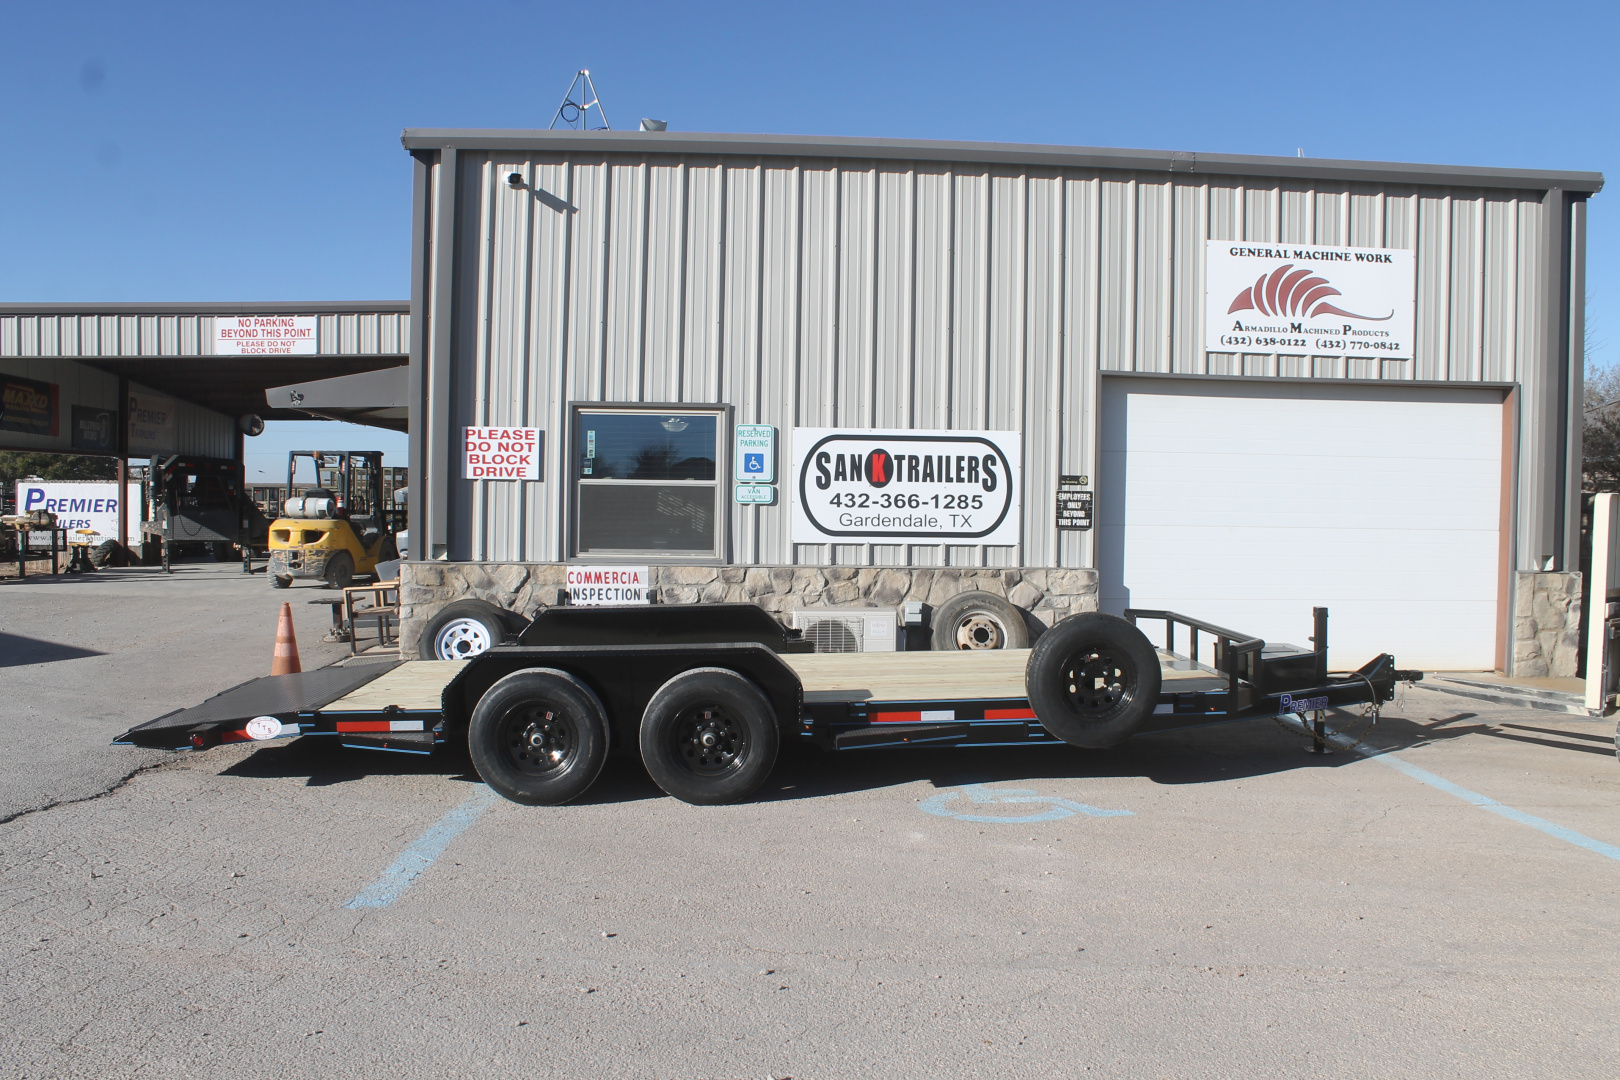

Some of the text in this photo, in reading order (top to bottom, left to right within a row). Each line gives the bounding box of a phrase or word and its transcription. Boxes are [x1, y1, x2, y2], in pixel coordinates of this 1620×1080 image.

[1229, 247, 1393, 264] GENERAL MACHINE WORK
[238, 318, 295, 328] NO PARKING
[221, 328, 312, 338] BEYOND THIS POINT
[236, 340, 265, 348] PLEASE
[1220, 335, 1401, 351] (432) 638-0122 (432) 770-0842
[128, 397, 167, 426] PREMIER
[465, 429, 535, 440] PLEASE
[738, 429, 771, 438] RESERVED
[465, 442, 536, 453] DO NOT
[740, 439, 769, 448] PARKING
[468, 454, 532, 465] BLOCK
[472, 466, 527, 478] DRIVE
[894, 453, 998, 492] TRAILERS
[25, 488, 118, 513] PREMIER
[829, 493, 984, 510] 432-366-1285
[1058, 492, 1091, 501] EMPLOYEES
[1067, 501, 1082, 509] ONLY
[1063, 510, 1086, 518] BEYOND
[56, 519, 91, 529] ILERS
[839, 513, 973, 529] Gardendale, TX
[1058, 518, 1090, 527] THIS POINT
[567, 571, 640, 585] COMMERCIA
[569, 587, 641, 601] INSPECTION
[1279, 694, 1329, 716] PREMIER
